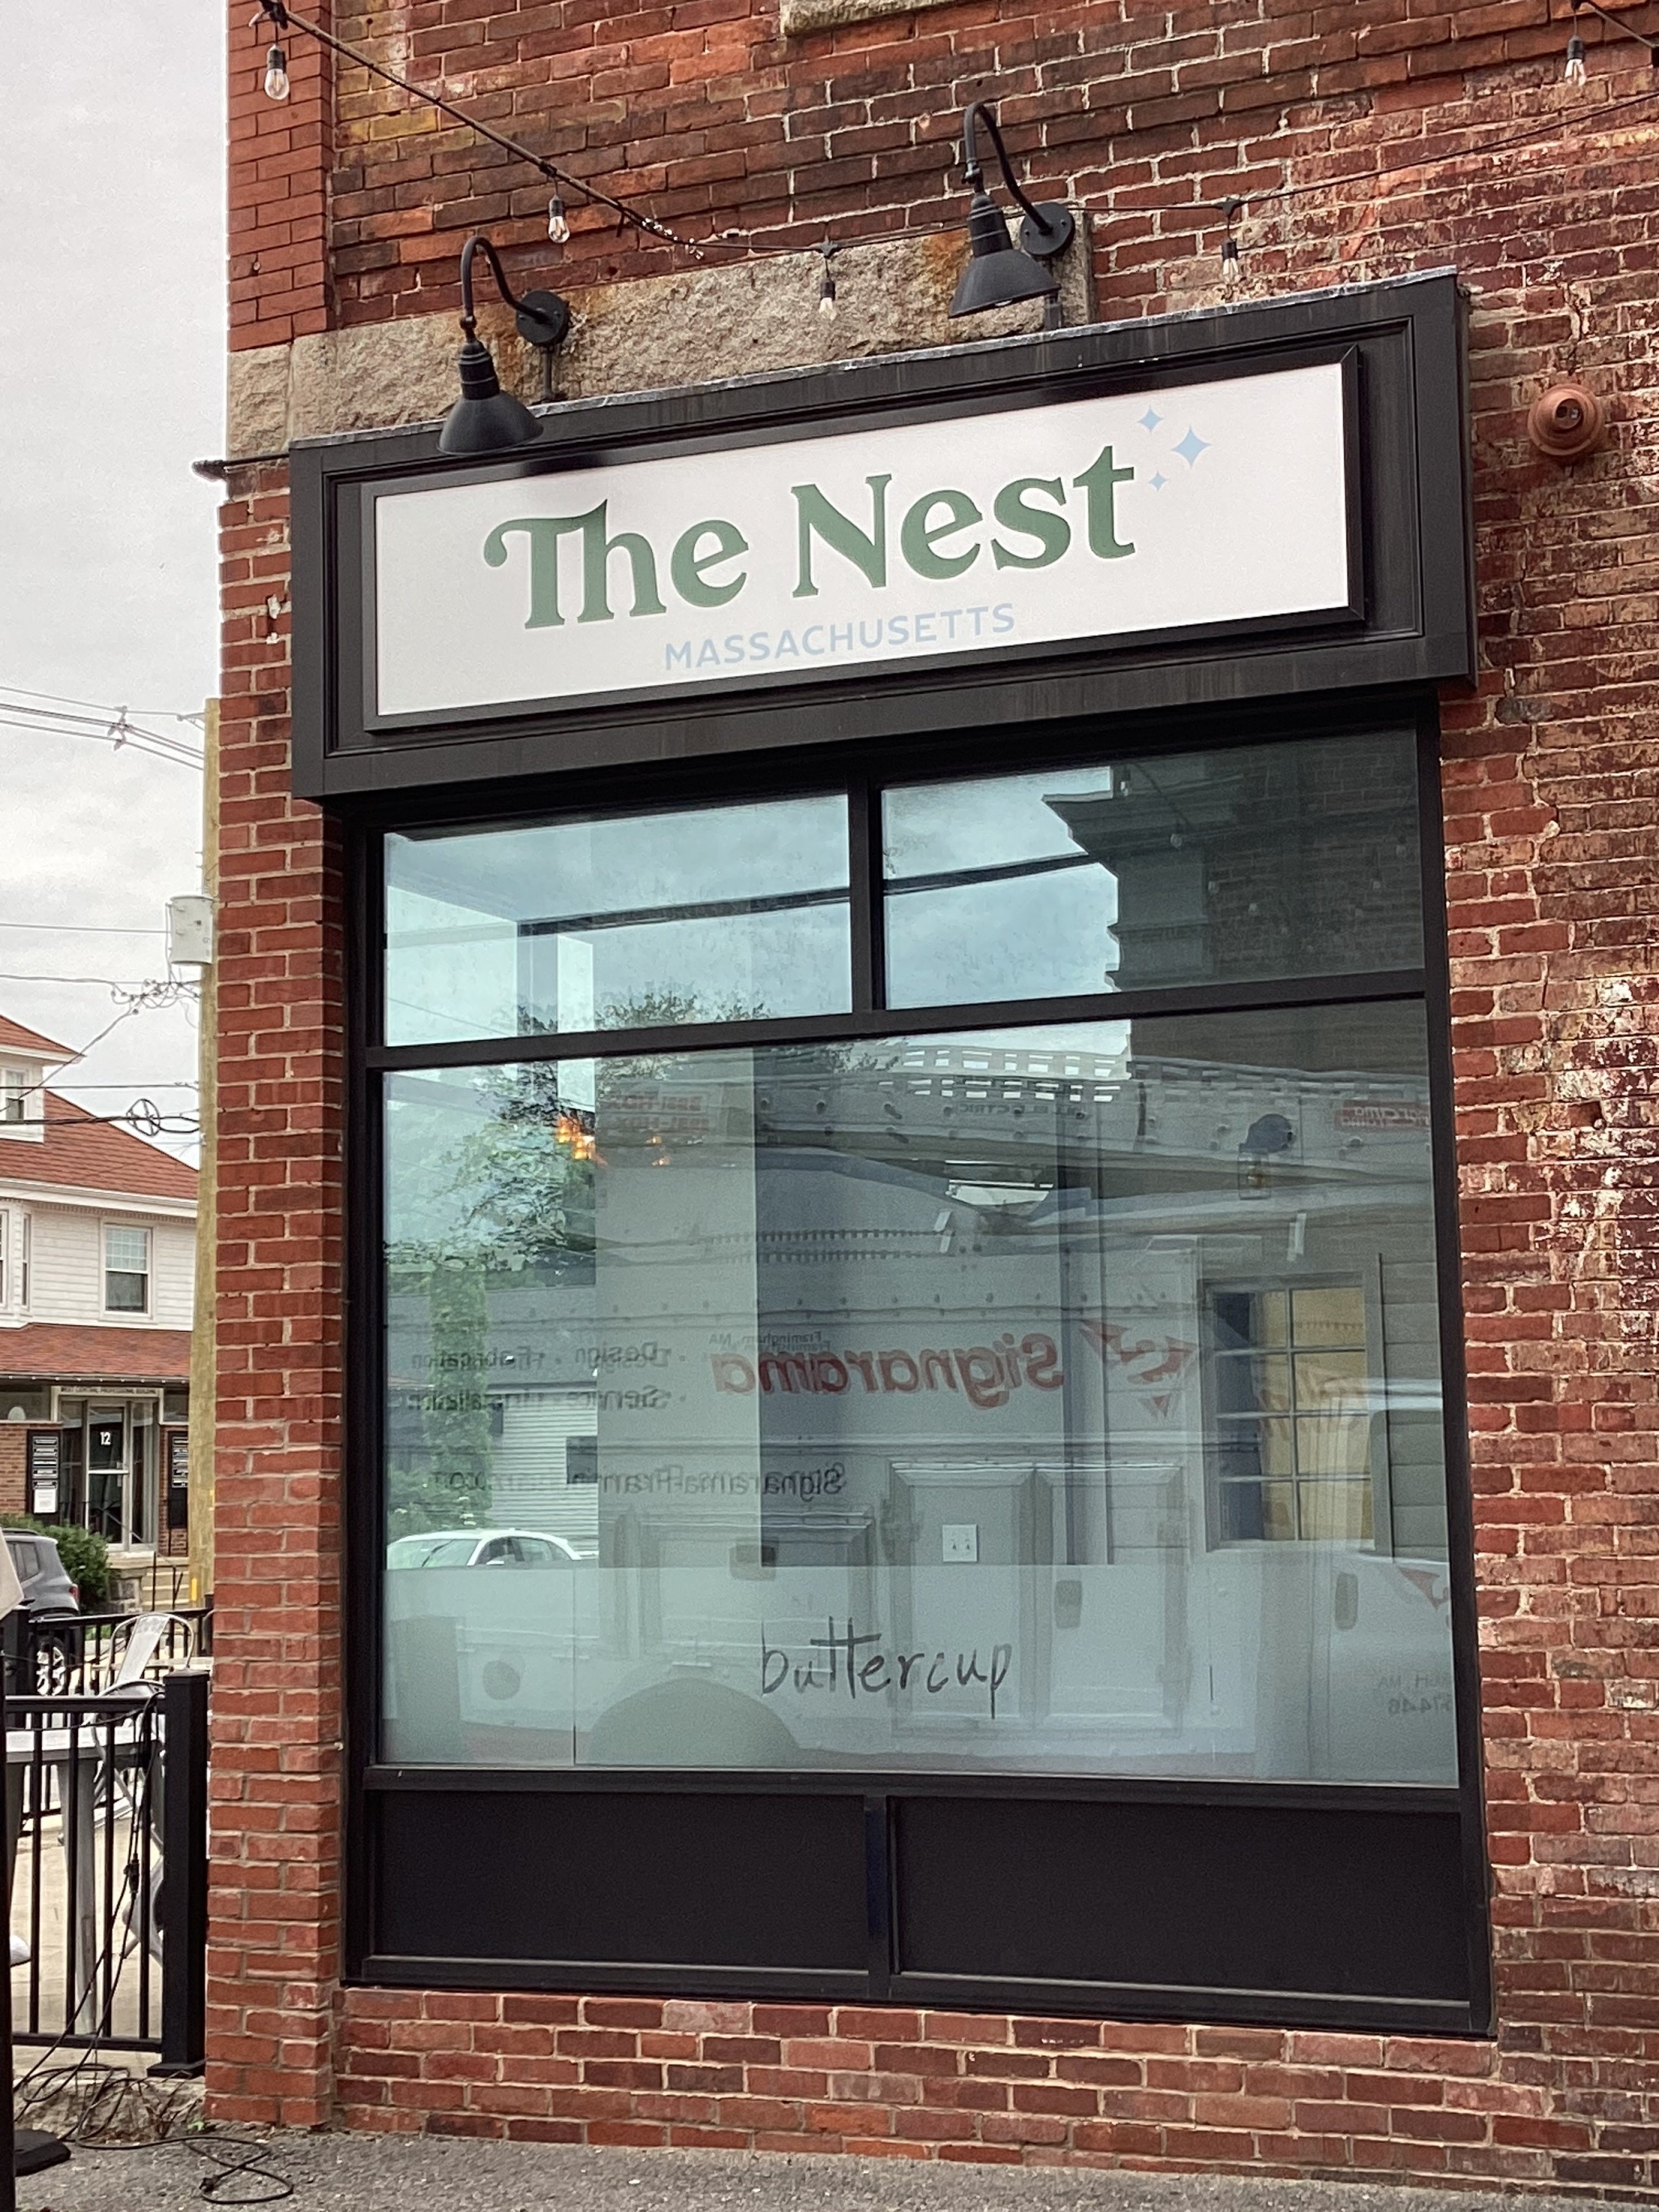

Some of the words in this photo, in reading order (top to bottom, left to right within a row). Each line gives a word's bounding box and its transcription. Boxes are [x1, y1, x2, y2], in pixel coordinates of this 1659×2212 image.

[483, 498, 749, 630] The
[791, 445, 1136, 598] Nest
[664, 603, 1016, 671] MASSACHUSETTS
[100, 1431, 112, 1446] 12
[759, 1616, 1013, 1720] buttercup
